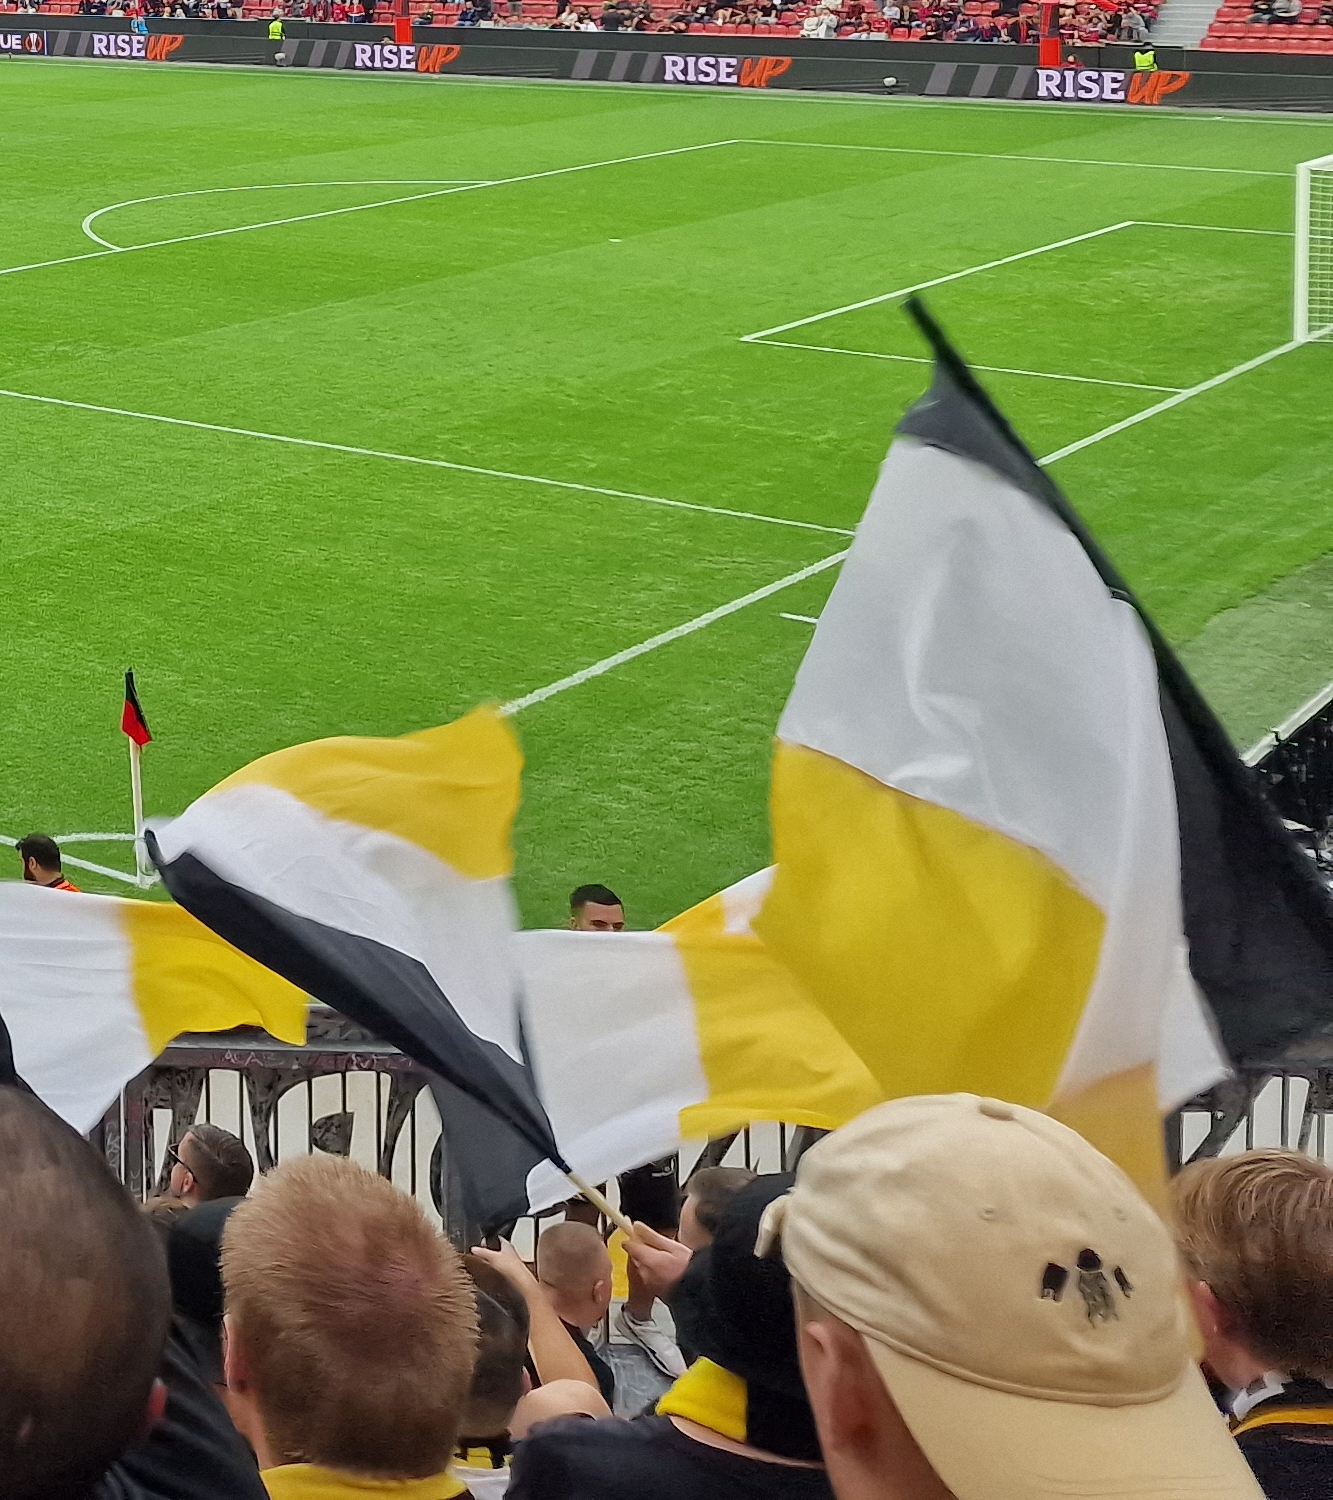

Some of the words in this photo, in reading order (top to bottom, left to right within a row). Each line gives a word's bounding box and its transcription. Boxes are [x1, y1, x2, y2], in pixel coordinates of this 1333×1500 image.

[92, 33, 145, 57] RISE
[145, 34, 185, 60] UP
[354, 43, 416, 70] RISE
[416, 44, 462, 73] UP
[663, 55, 738, 84] RISE
[738, 56, 793, 88] UP
[1036, 69, 1126, 101] RISE
[1127, 70, 1192, 105] UP
